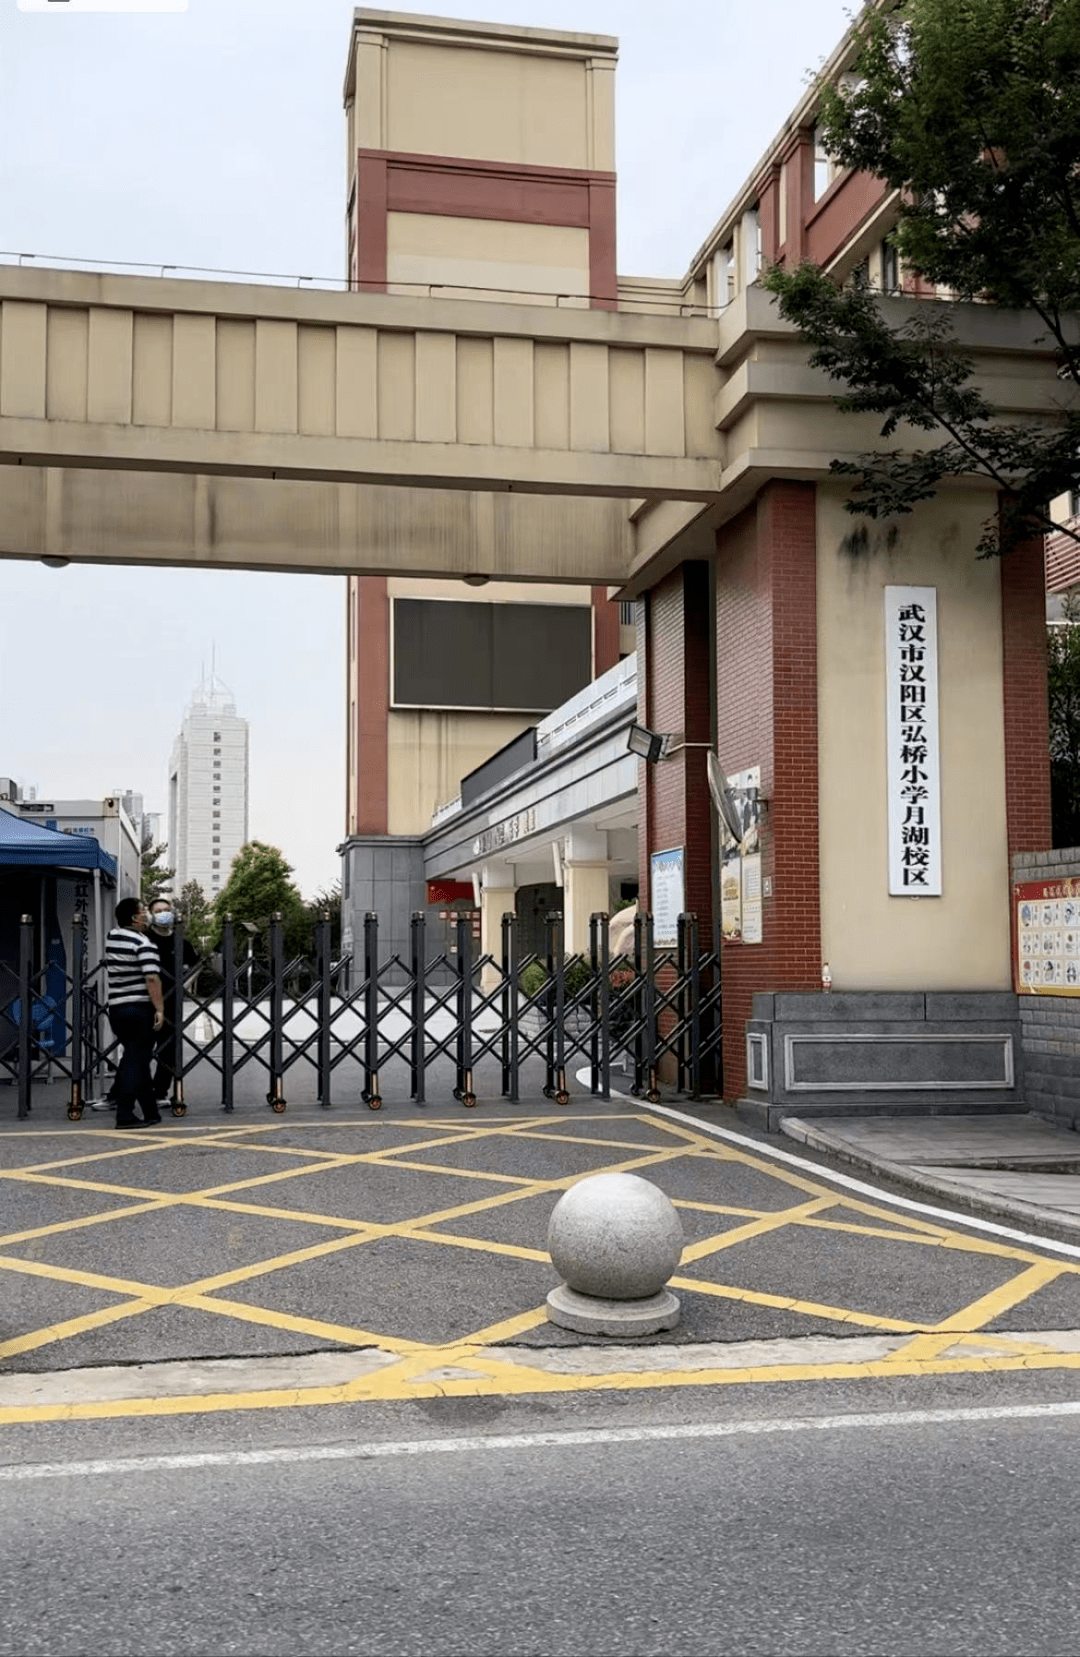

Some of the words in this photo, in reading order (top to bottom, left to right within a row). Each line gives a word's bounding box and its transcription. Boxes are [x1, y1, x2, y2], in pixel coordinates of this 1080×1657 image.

[898, 604, 929, 886] 武汉市汉阳区弘桥小学月湖校区
